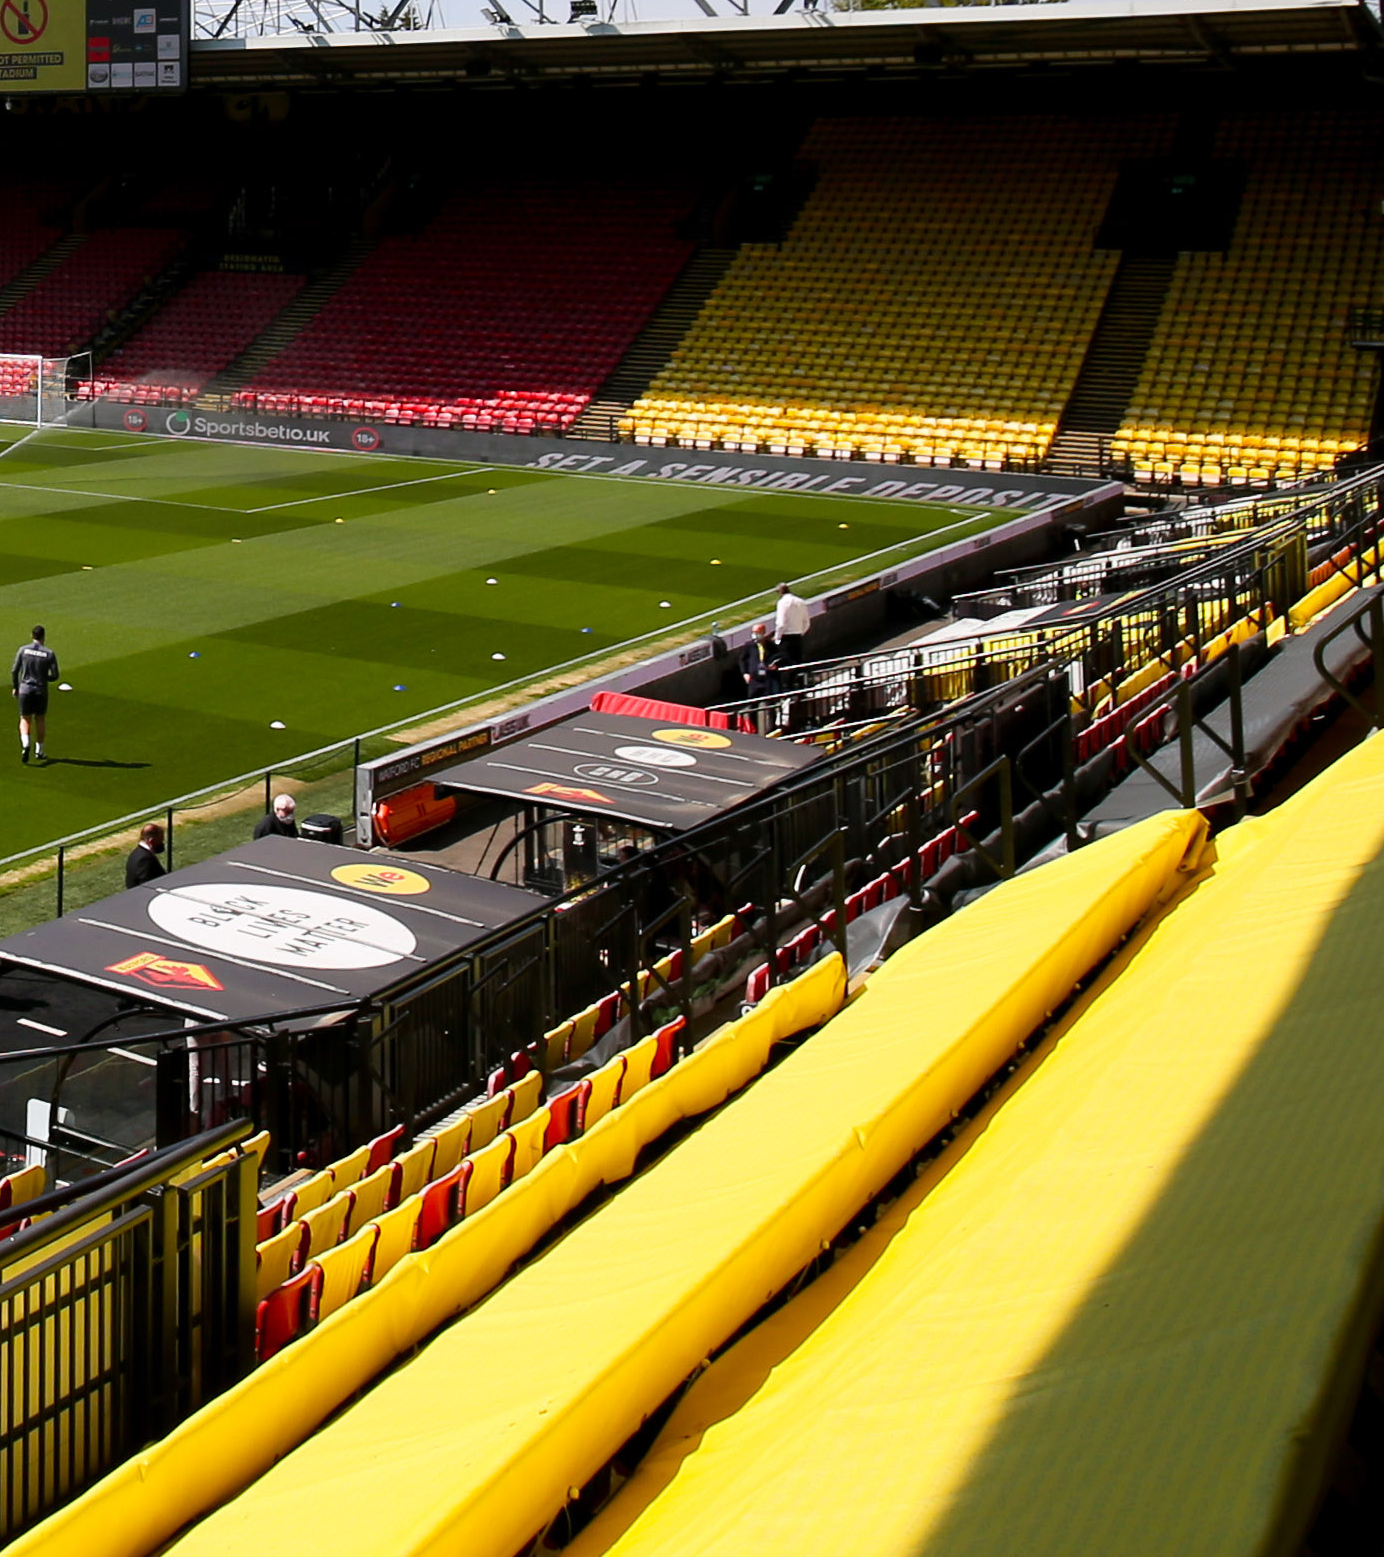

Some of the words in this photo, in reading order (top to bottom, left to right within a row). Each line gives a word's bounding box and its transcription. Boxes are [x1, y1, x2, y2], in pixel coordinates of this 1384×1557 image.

[11, 54, 62, 65] PERMITTED
[127, 414, 143, 425] 18+
[194, 417, 331, 443] Sportsbetio.uk
[356, 433, 376, 444] 18+
[525, 452, 615, 472] SET
[606, 459, 648, 476] A
[646, 463, 868, 493] SENSIBLE
[862, 479, 1080, 511] DEPOSIT
[410, 756, 421, 770] FC
[354, 870, 406, 889] We
[236, 908, 312, 940] LIVES
[274, 916, 371, 958] MATTER
